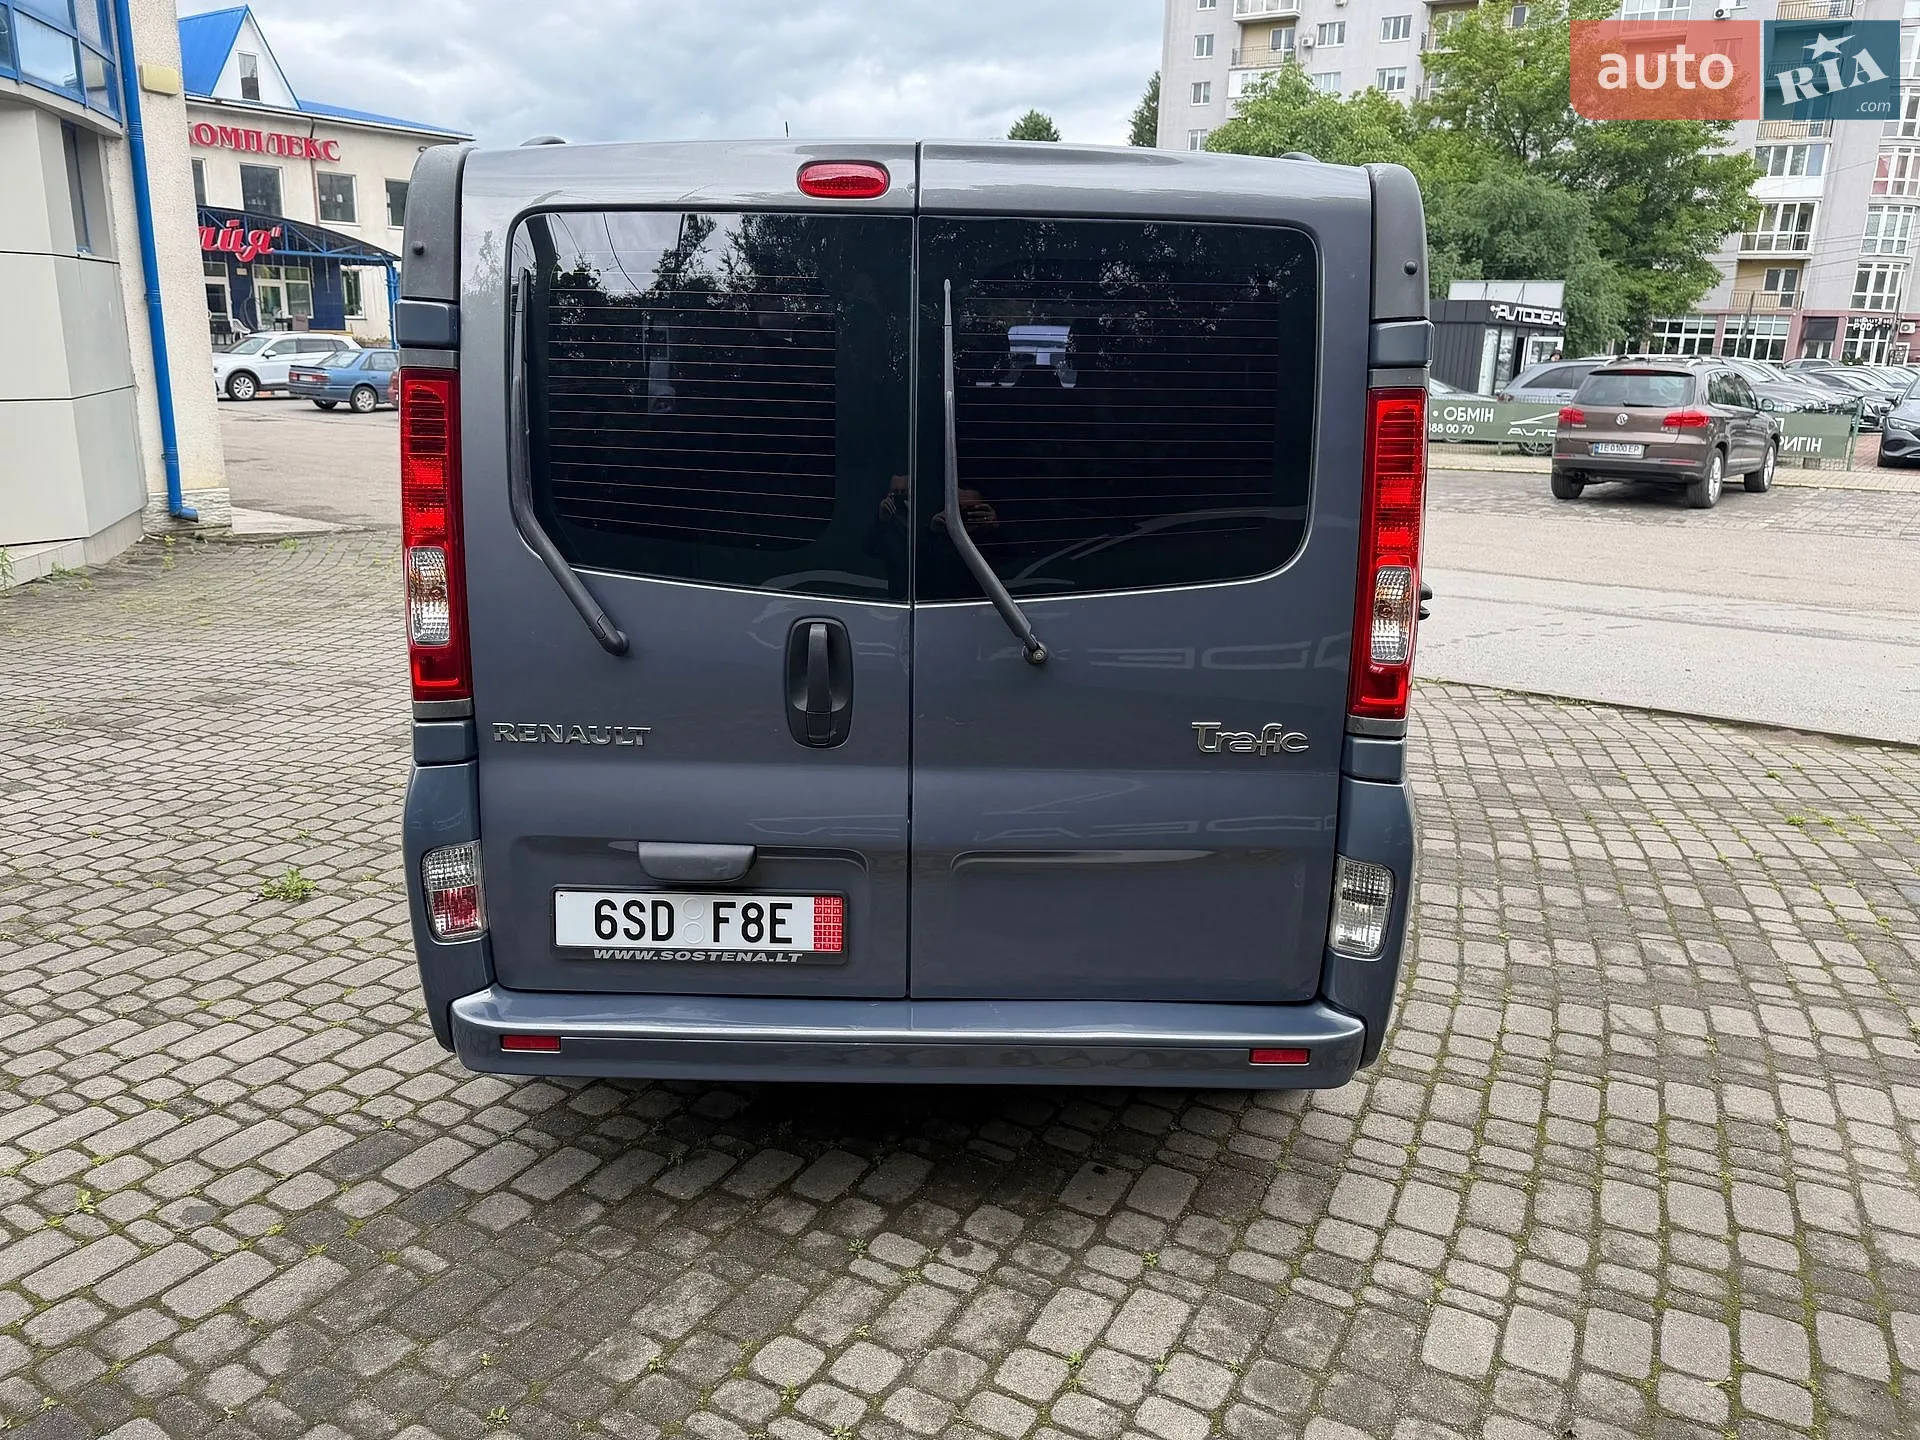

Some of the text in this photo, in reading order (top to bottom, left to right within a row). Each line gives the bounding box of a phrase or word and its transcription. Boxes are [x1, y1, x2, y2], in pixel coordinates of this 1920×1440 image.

[188, 122, 342, 163] ОМПЛЕКС
[1443, 406, 1495, 423] ОБМІН
[1445, 423, 1460, 434] 00
[1461, 424, 1475, 435] 70
[491, 721, 653, 747] RENAULT
[1191, 721, 1310, 757] Trafic
[594, 898, 675, 942] 6SD
[712, 901, 793, 944] F8E
[593, 949, 803, 963] WWW.SOSTENA.LT
